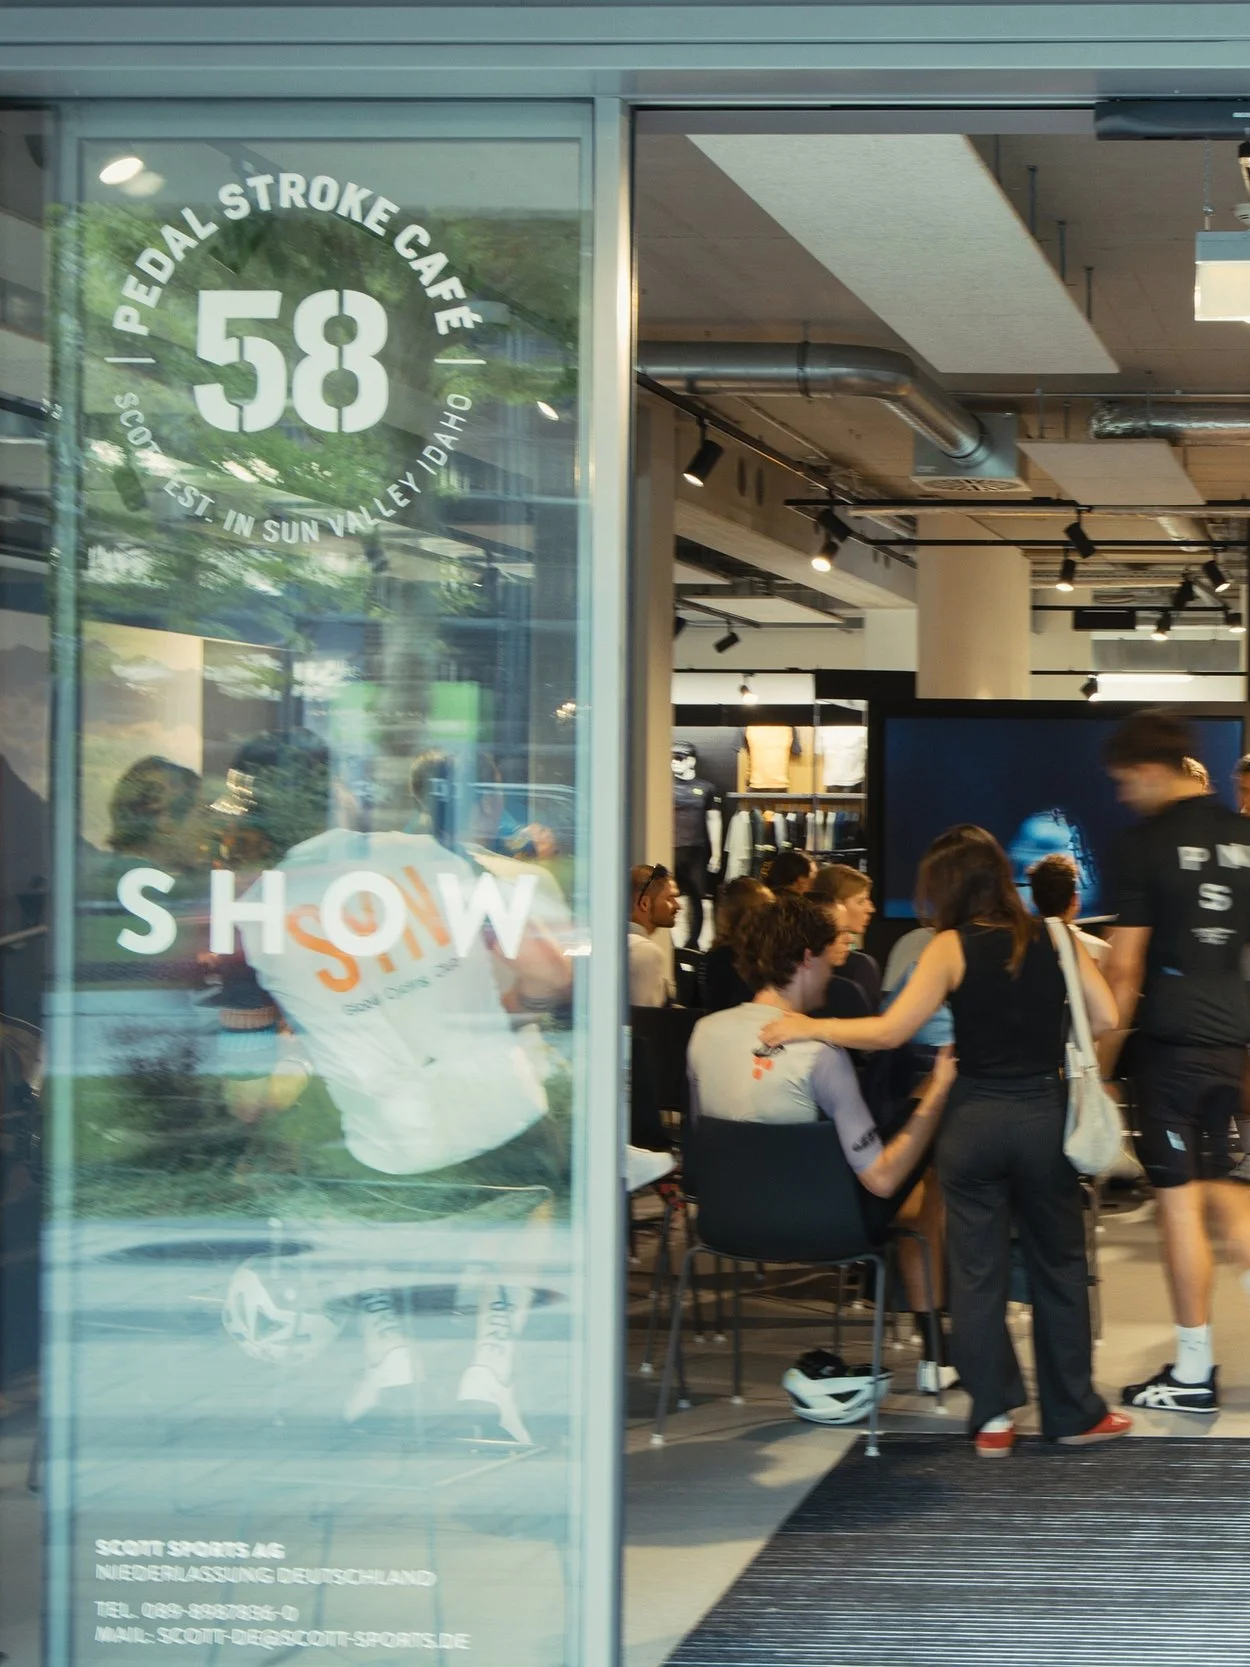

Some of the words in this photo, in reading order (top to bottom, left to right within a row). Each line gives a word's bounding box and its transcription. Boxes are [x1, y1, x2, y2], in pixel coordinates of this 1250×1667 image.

[112, 207, 219, 336] PEDAL
[217, 172, 400, 237] STROKE
[394, 224, 484, 335] CAFÉ
[193, 289, 390, 433] 58
[222, 509, 255, 538] IN
[262, 519, 320, 544] SUN
[327, 471, 422, 538] VALLEY
[416, 393, 473, 476] IDAHO
[116, 867, 538, 959] SHOW
[95, 1538, 165, 1557] SCOTT
[166, 1540, 250, 1558] SPORTS
[252, 1542, 286, 1559] AG
[96, 1563, 275, 1584] NIEDERLASSUNG
[277, 1567, 438, 1587] DEUTSCHLAND
